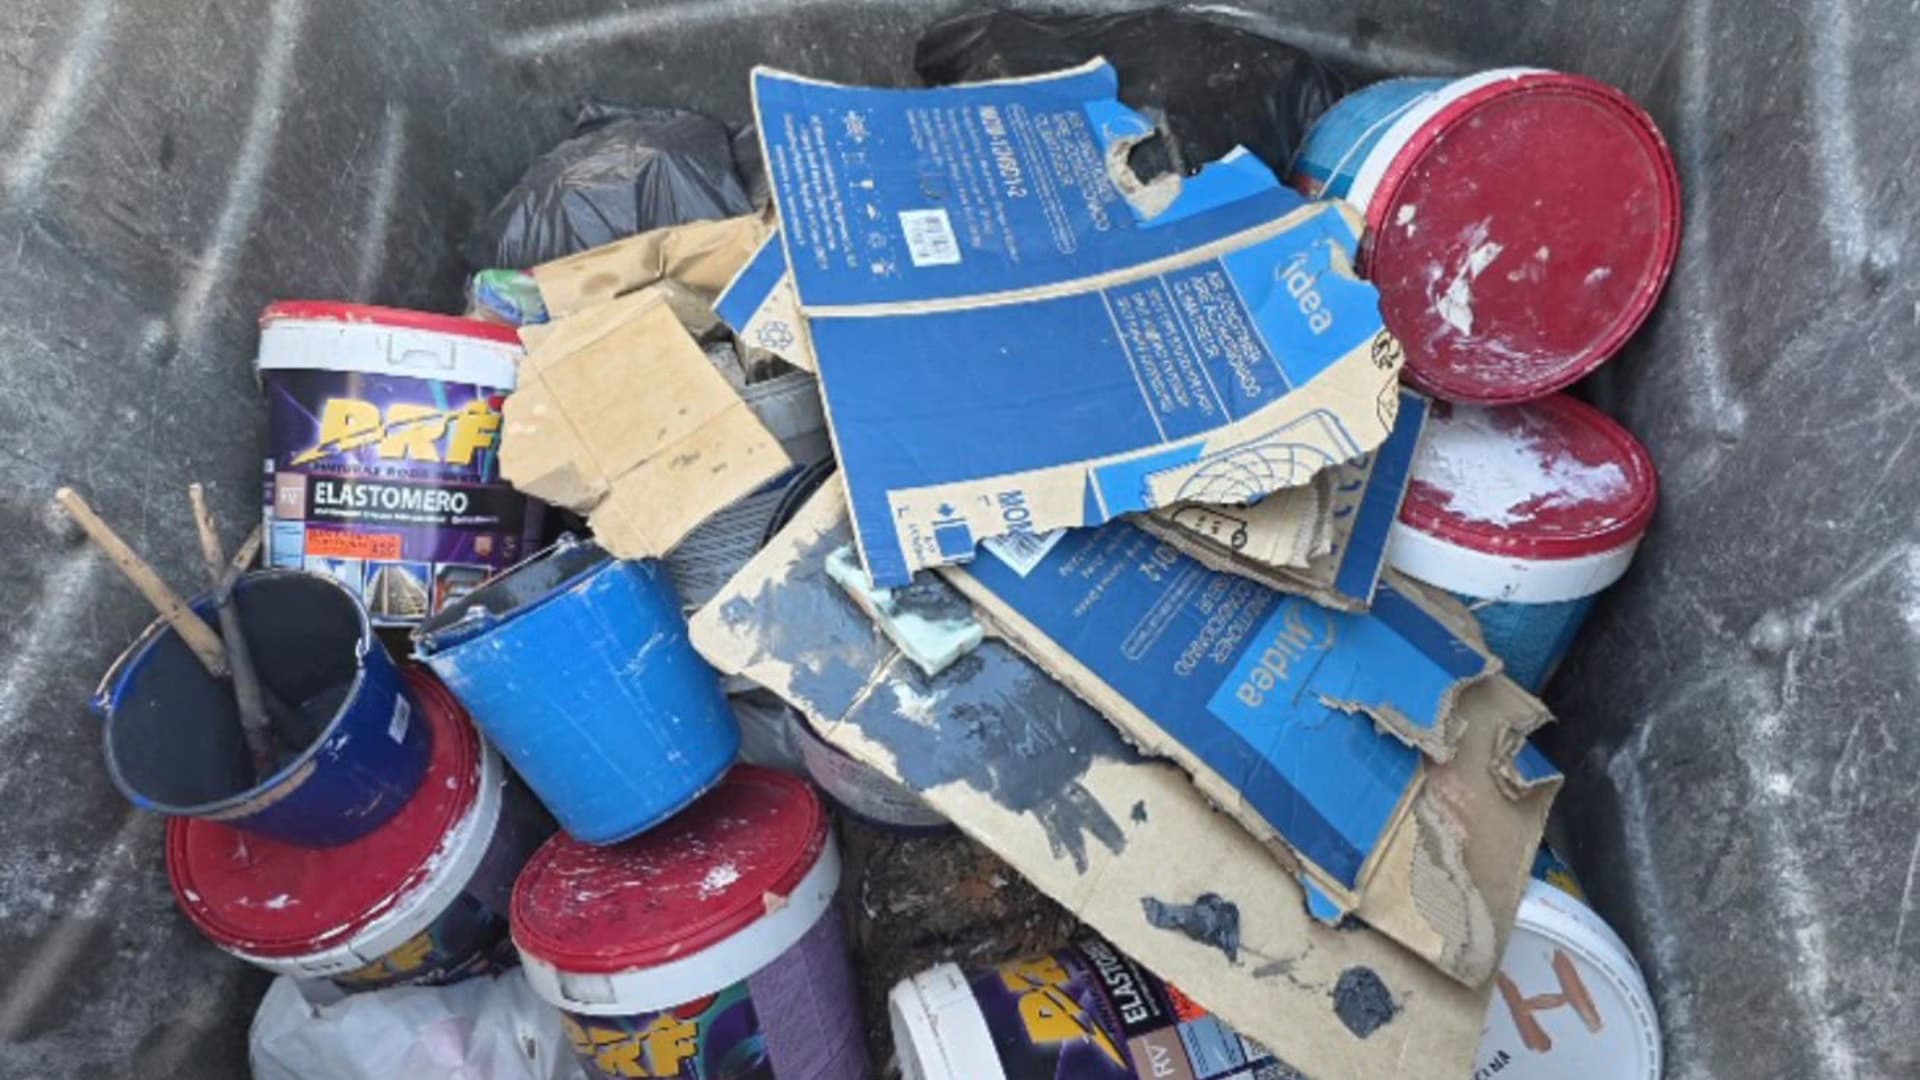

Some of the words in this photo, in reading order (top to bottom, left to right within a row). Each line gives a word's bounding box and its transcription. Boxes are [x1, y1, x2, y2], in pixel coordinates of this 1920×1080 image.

[1280, 252, 1333, 335] idea
[314, 482, 469, 513] ELASTOMERO
[1236, 602, 1316, 708] Midea
[1495, 947, 1605, 1054] H
